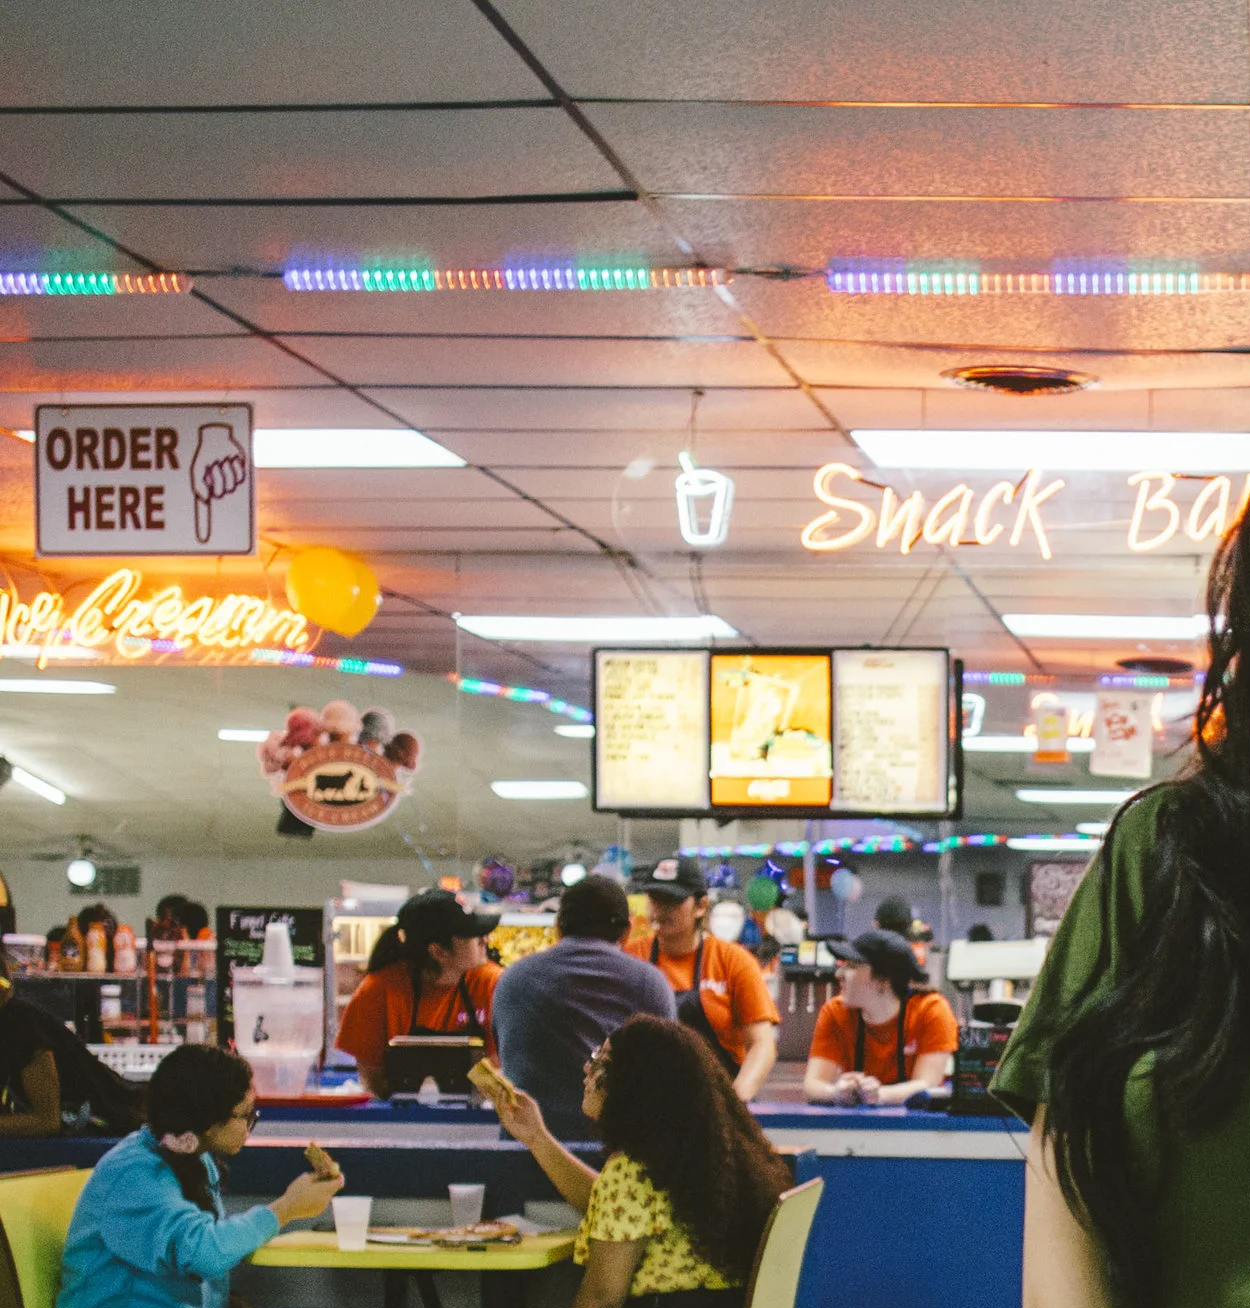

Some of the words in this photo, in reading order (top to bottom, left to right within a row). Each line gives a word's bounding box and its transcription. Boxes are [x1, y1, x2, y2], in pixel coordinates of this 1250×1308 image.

[45, 426, 180, 471] ORDER
[66, 485, 166, 531] HERE
[800, 461, 1066, 560] Snack
[70, 567, 311, 659] Cream
